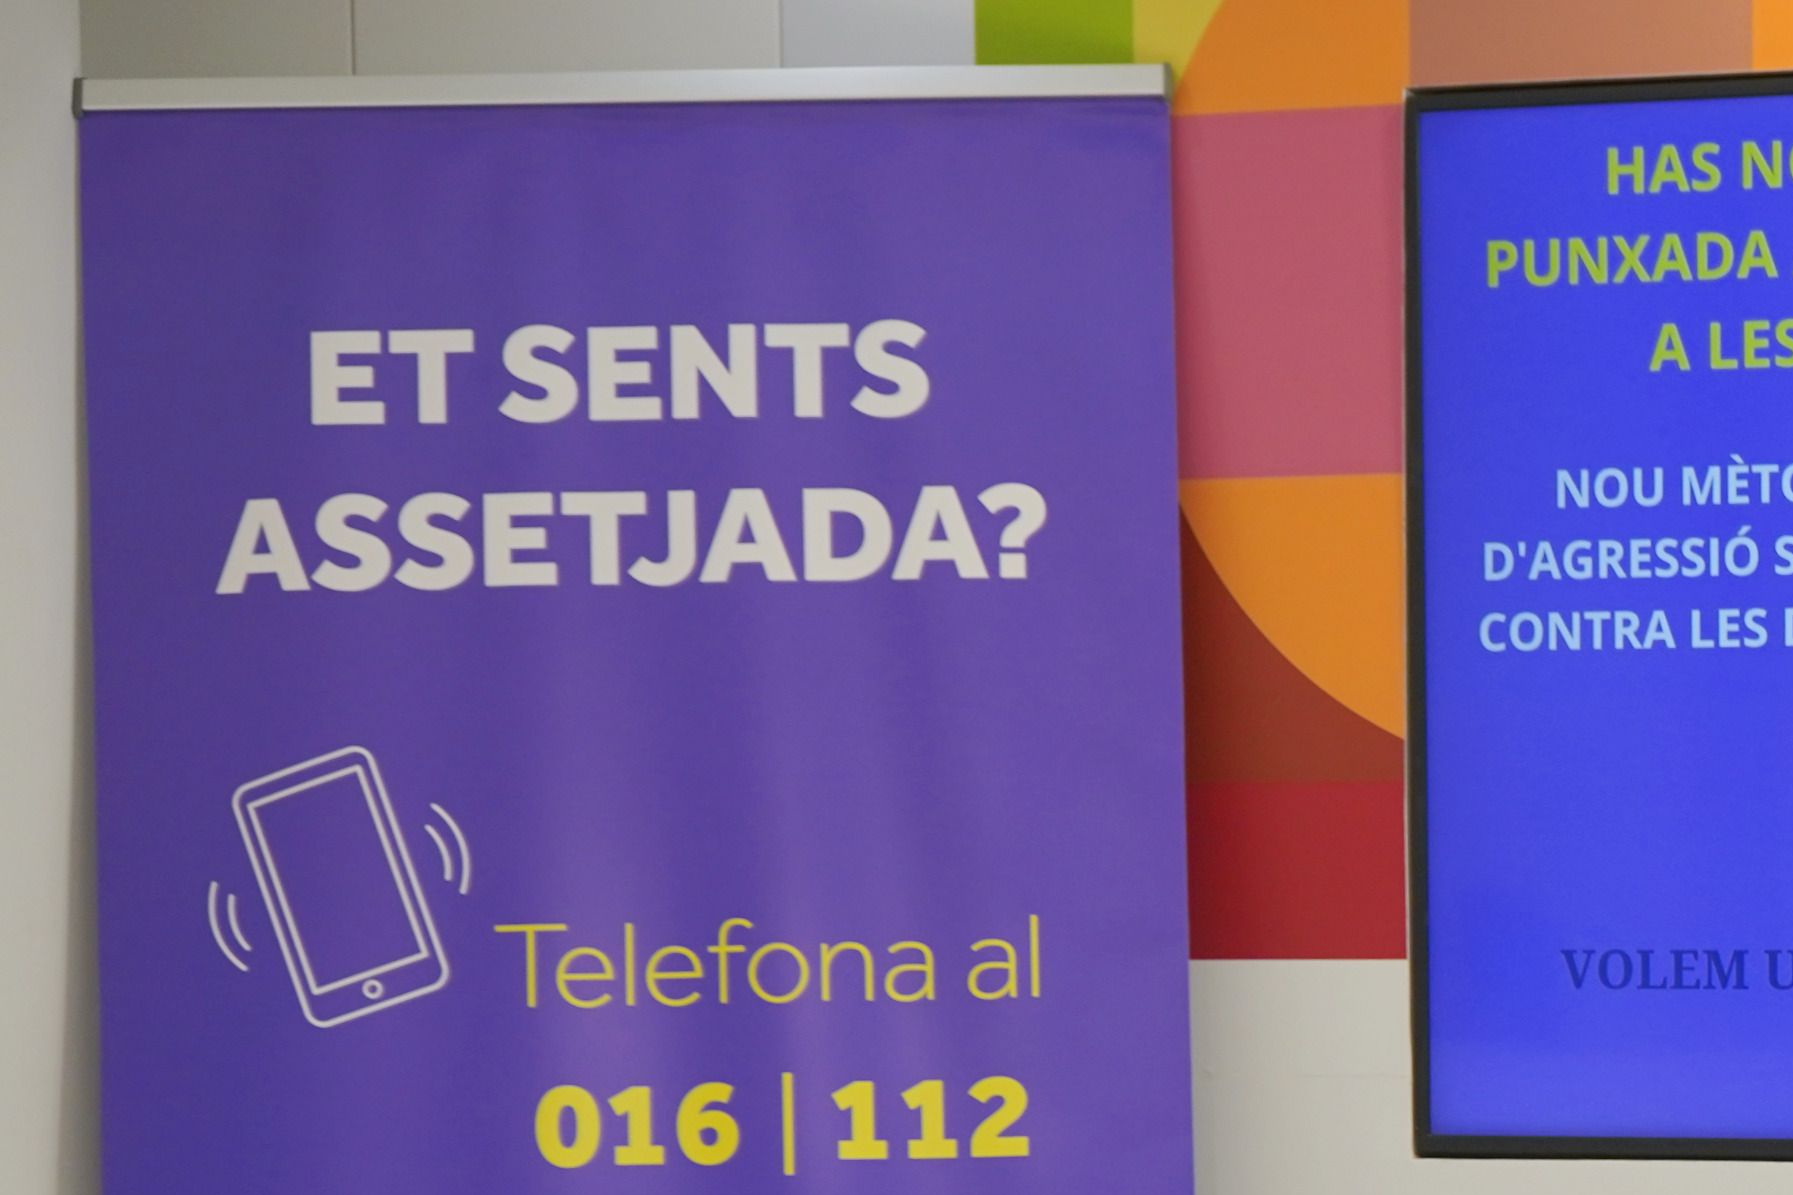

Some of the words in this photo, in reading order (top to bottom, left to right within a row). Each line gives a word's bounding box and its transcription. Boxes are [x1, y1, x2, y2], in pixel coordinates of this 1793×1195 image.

[1607, 142, 1721, 194] HAS
[1487, 230, 1778, 287] PUNXADA
[311, 329, 474, 425] ET
[499, 319, 930, 423] SENTS
[1650, 323, 1690, 371] A
[1557, 467, 1663, 508] NOU
[216, 483, 1047, 594] ASSETJADA?
[1484, 526, 1759, 581] D'AGRESSIÓ
[1480, 610, 1676, 652] CONTRA
[1691, 608, 1767, 648] LES
[495, 918, 935, 1008] Telefona
[968, 915, 1040, 1000] al
[1560, 949, 1749, 990] VOLEM
[535, 1082, 739, 1168] 016
[832, 1076, 1029, 1159] 112
